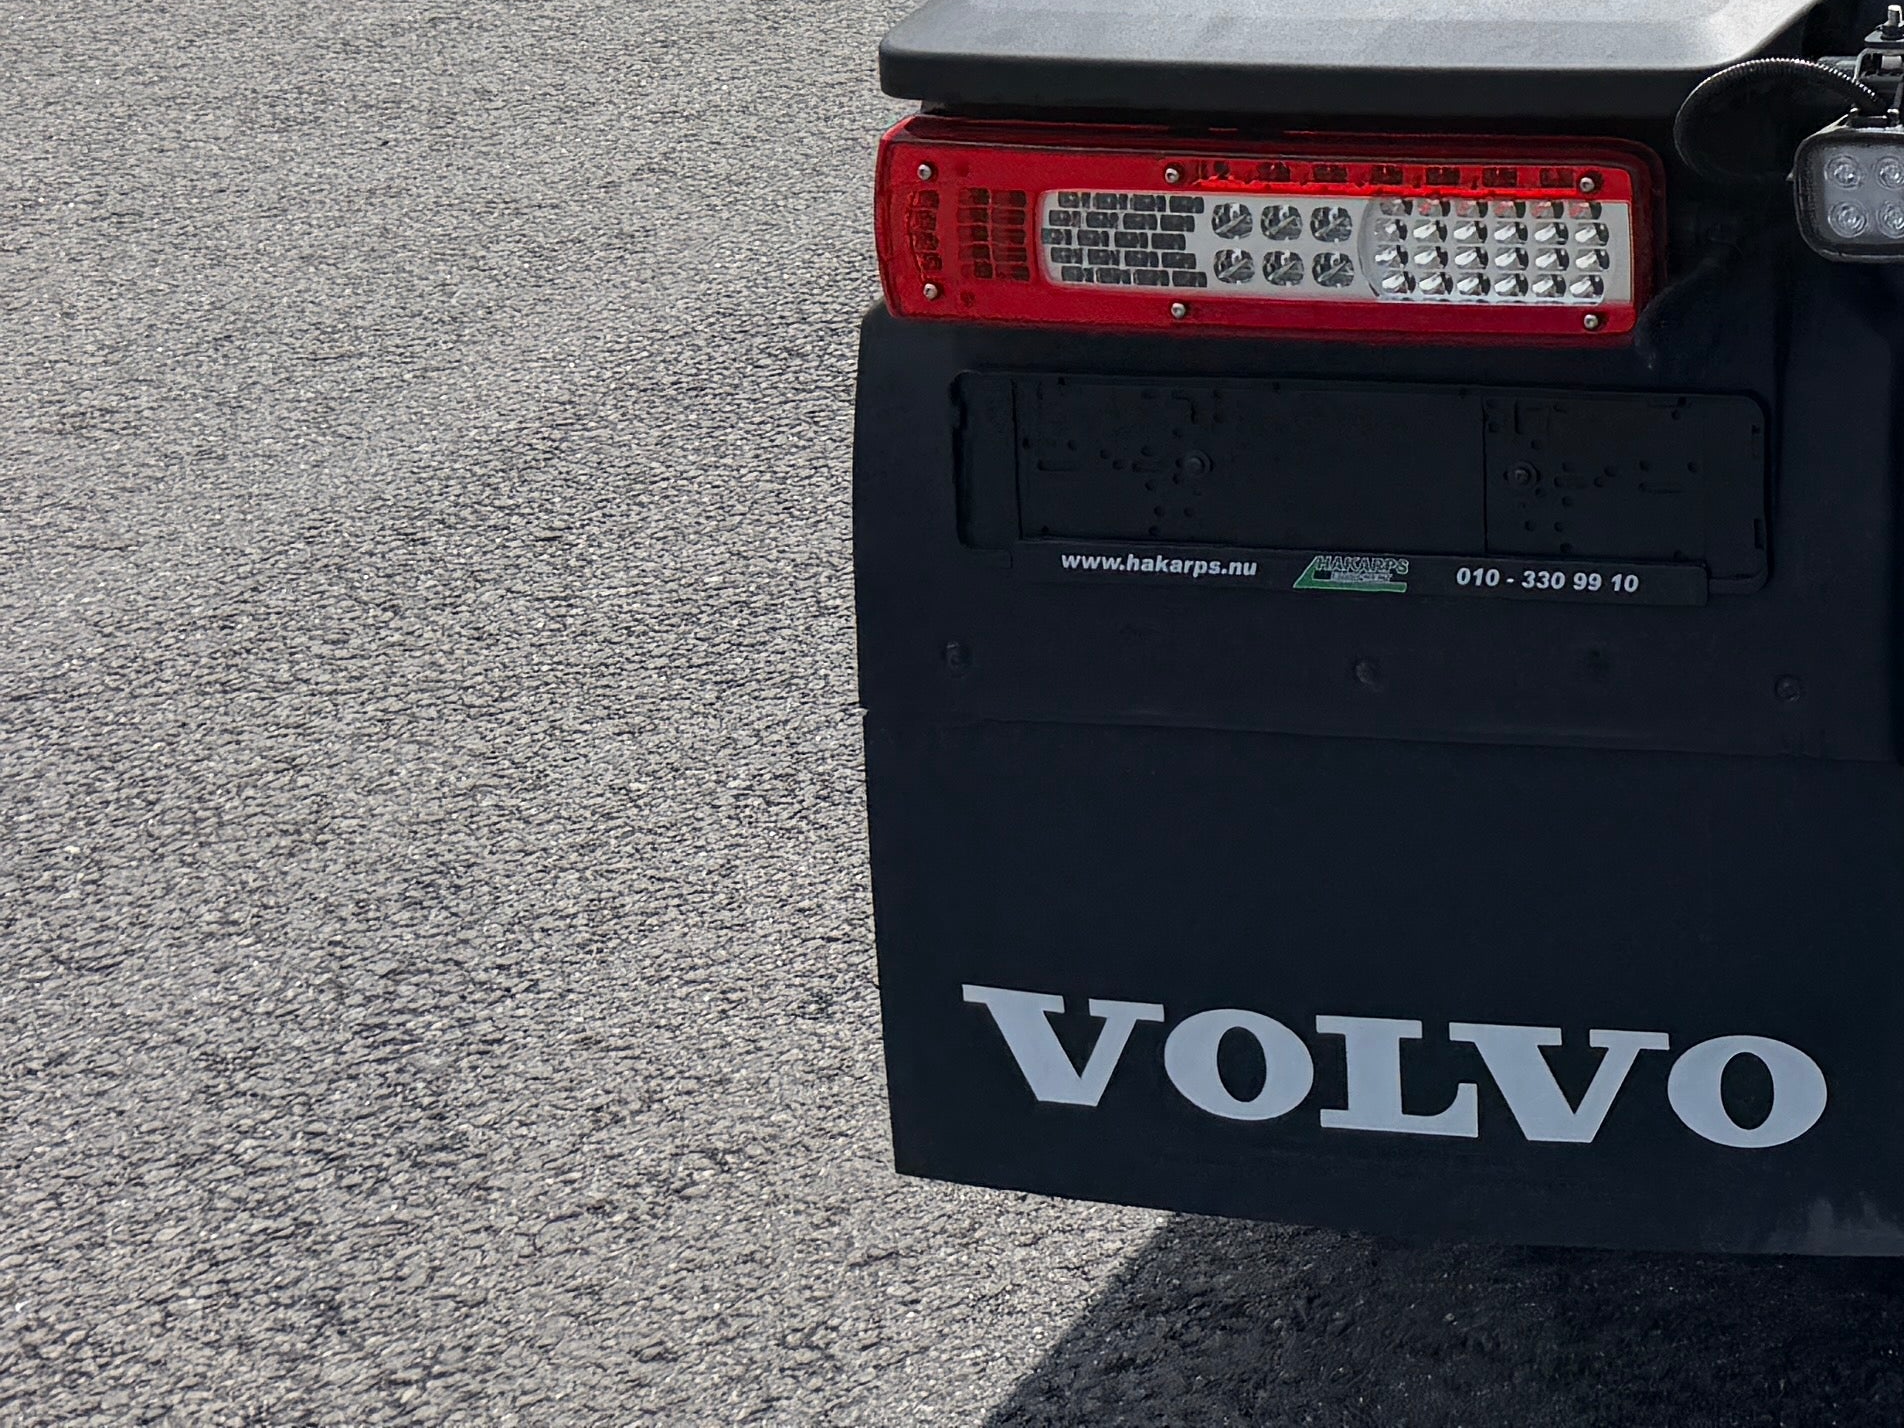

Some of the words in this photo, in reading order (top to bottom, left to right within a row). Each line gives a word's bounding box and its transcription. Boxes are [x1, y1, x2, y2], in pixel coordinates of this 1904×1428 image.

[1061, 553, 1257, 578] www.hakarps.nu
[1315, 555, 1409, 575] HAKARPS
[1456, 567, 1500, 587] 010
[1521, 570, 1566, 590] 330
[1573, 572, 1602, 592] 99
[1611, 573, 1639, 593] 10
[962, 984, 1828, 1149] VOLVO
